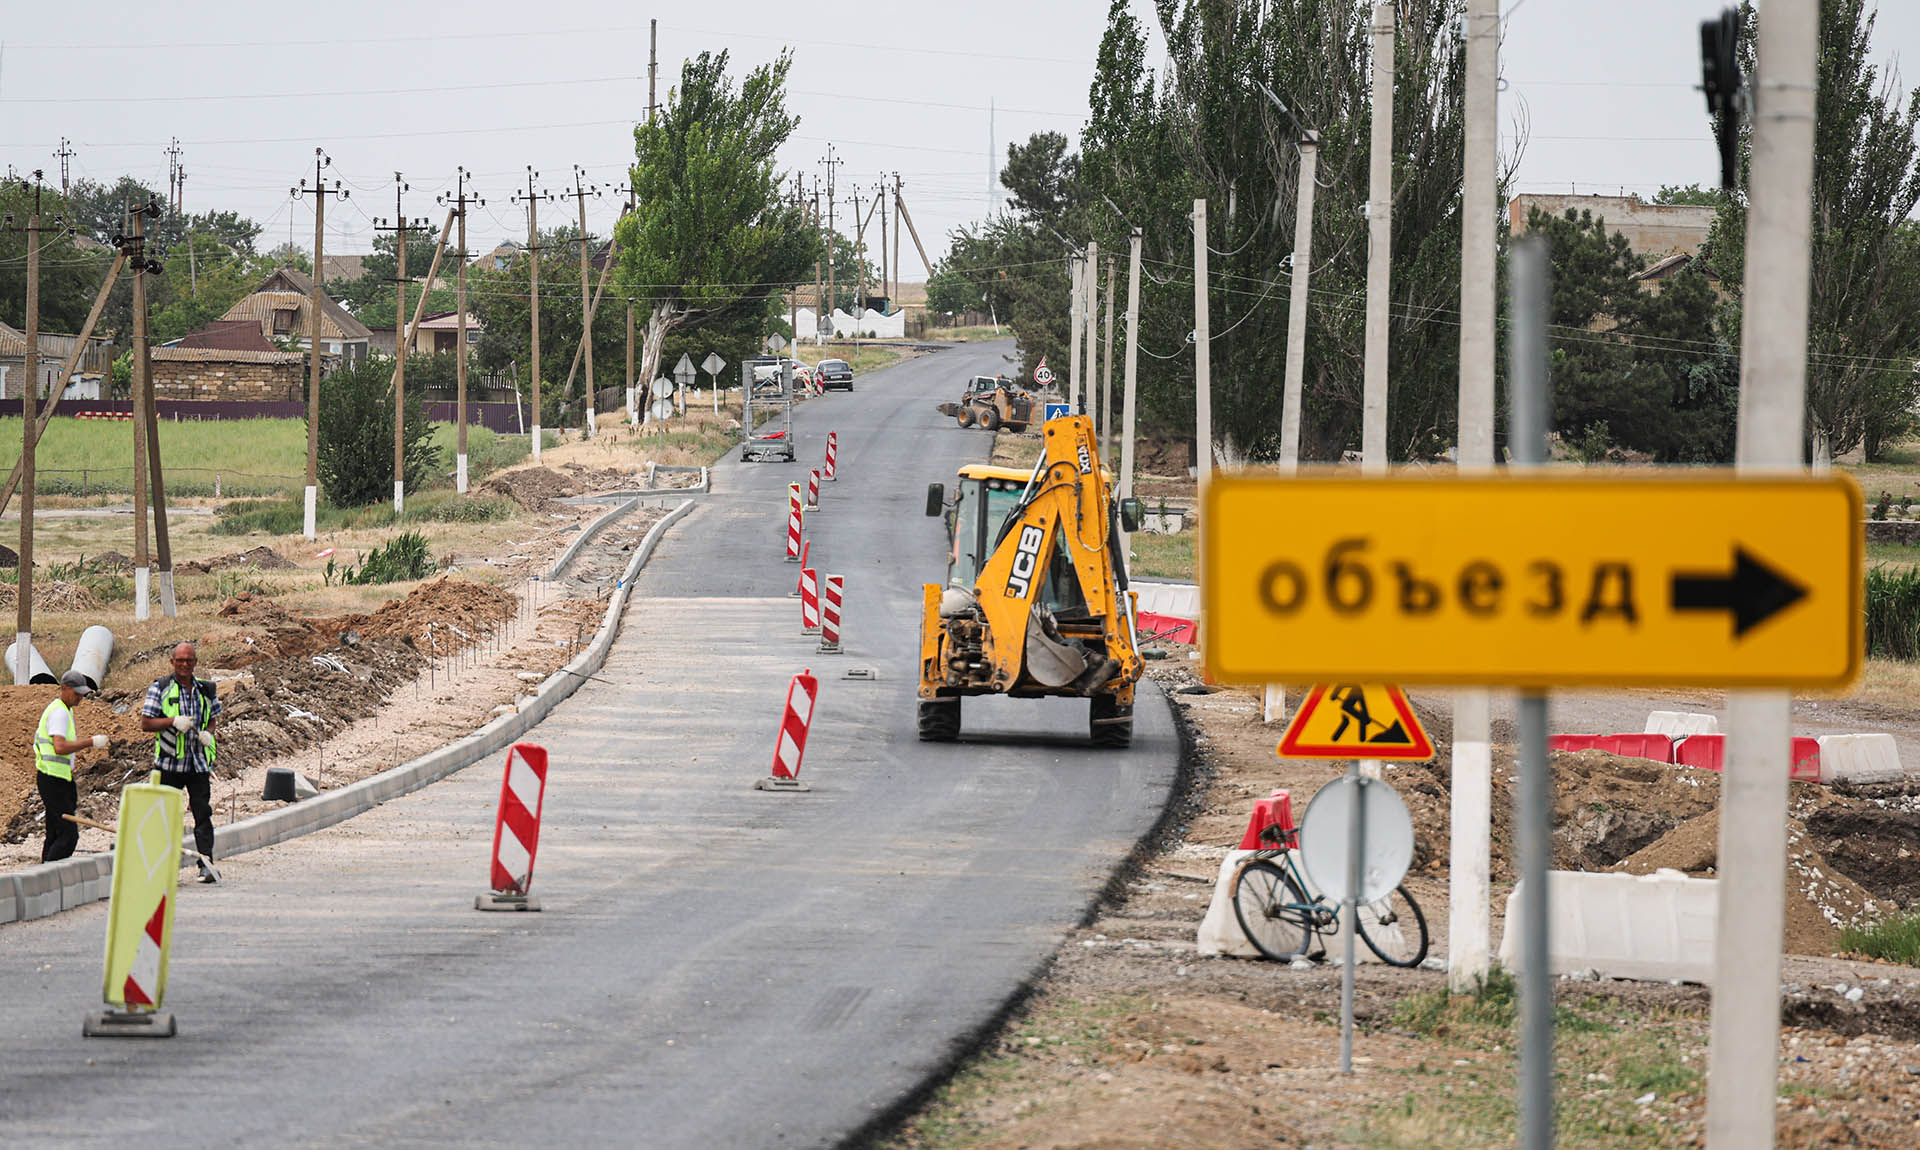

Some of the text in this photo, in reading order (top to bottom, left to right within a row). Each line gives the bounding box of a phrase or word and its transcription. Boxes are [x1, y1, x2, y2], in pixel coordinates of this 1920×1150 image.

[1038, 371, 1050, 379] 40
[1009, 526, 1043, 599] JCB
[1258, 536, 1639, 628] объезд
